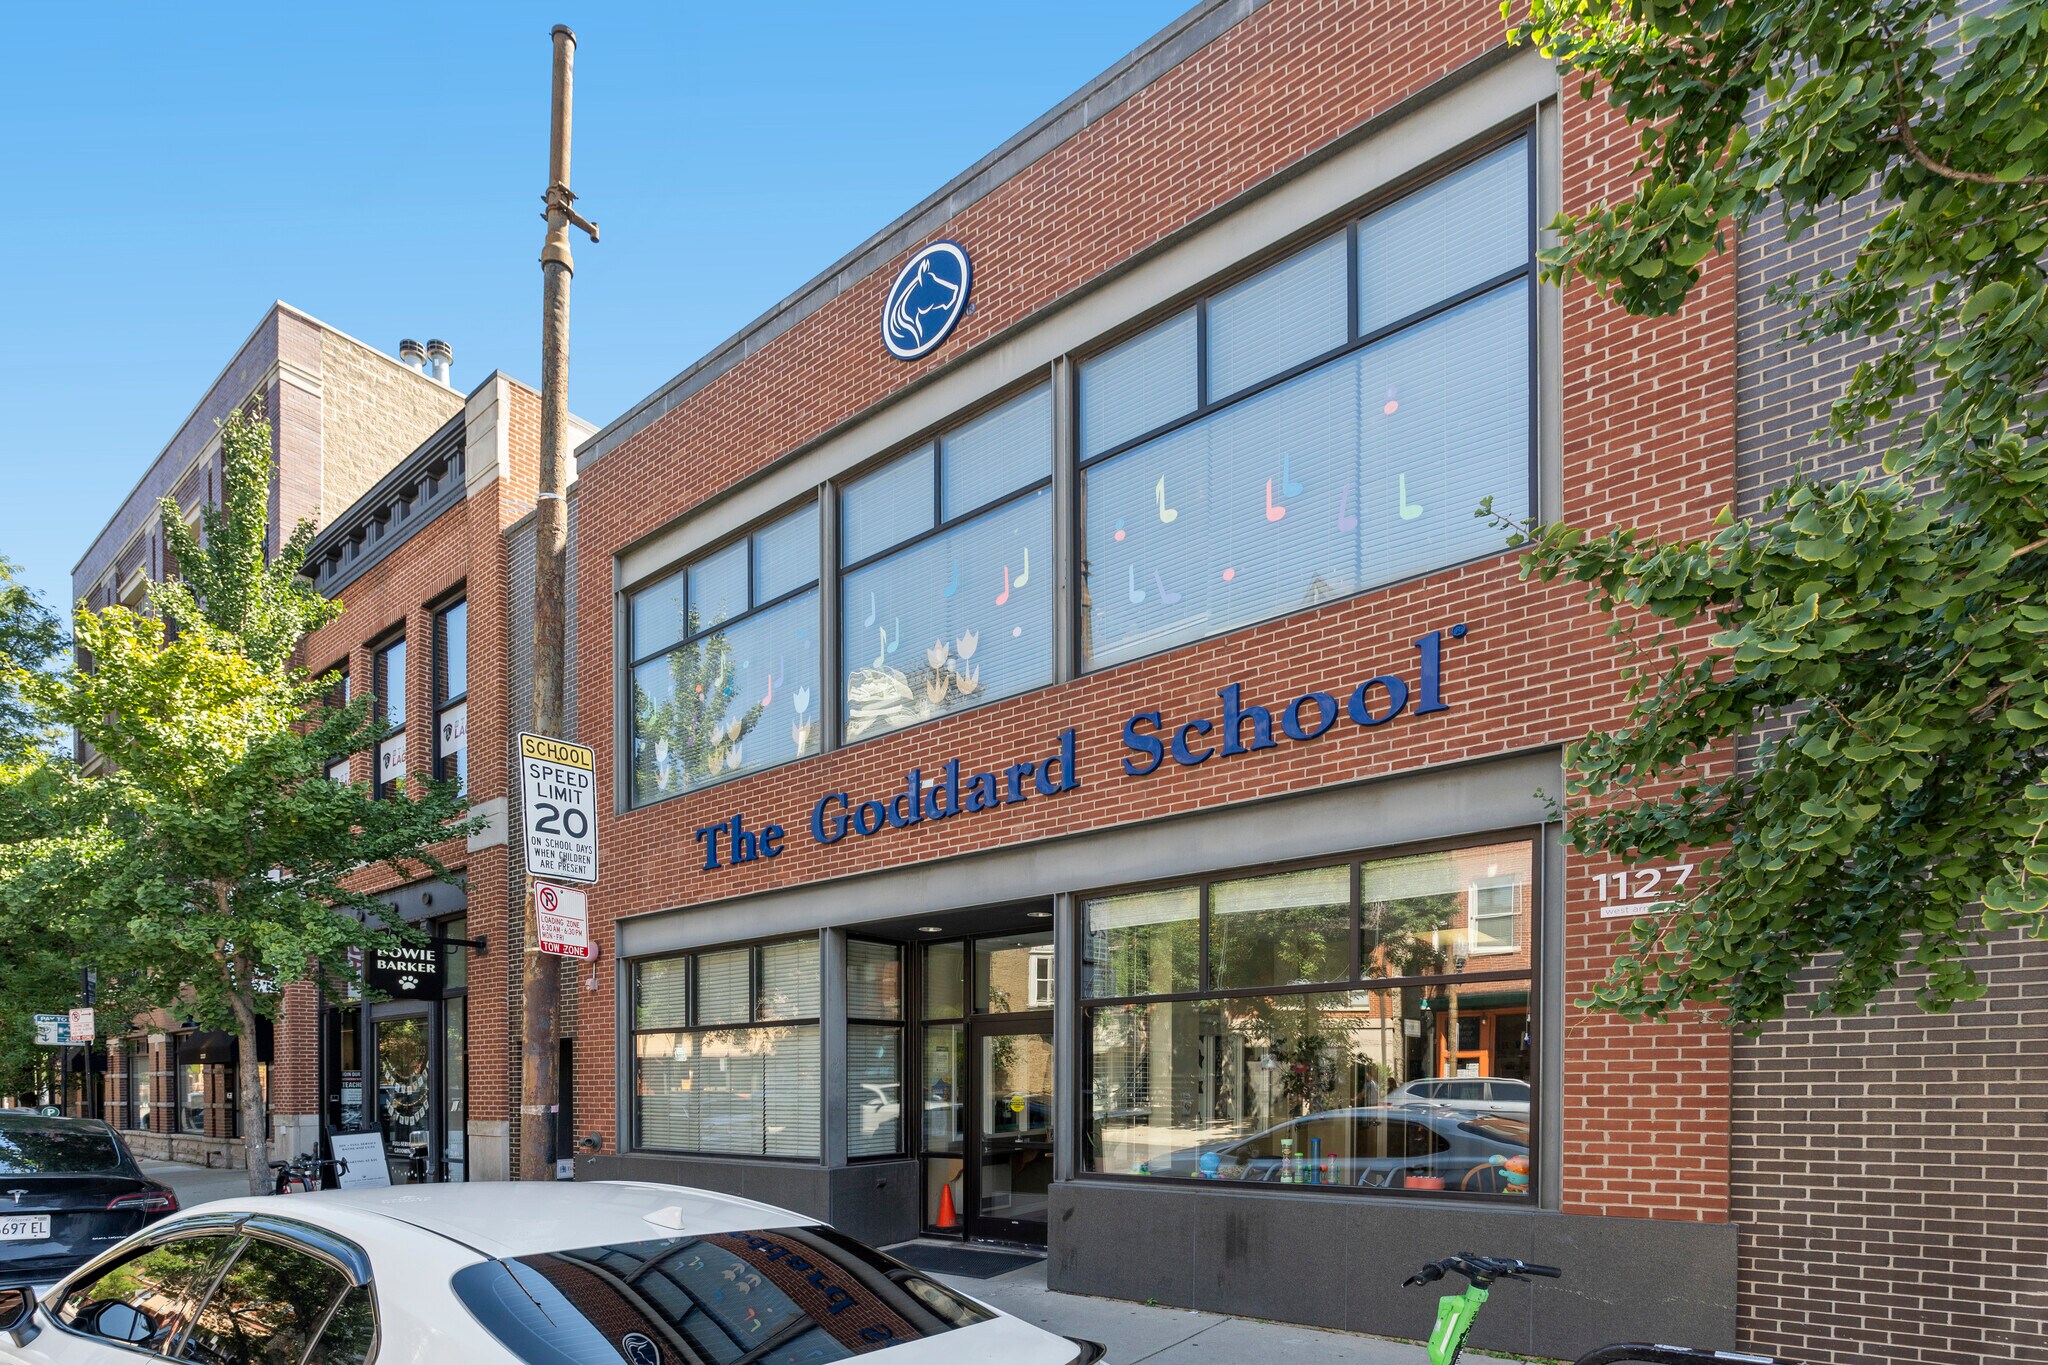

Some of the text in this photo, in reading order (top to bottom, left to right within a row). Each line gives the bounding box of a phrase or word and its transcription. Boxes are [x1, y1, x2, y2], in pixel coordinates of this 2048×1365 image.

[526, 739, 590, 766] SCHOOL
[530, 764, 588, 789] SPEED
[537, 782, 582, 804] LIMIT
[694, 810, 785, 872] The
[810, 728, 1081, 845] Goddard
[534, 803, 588, 839] 20
[531, 836, 593, 855] ON SCHOOL DAYS
[534, 848, 591, 865] WHEN CHILDREN
[540, 859, 554, 870] ARE
[558, 862, 587, 875] PRESENT
[1592, 864, 1693, 902] 1127
[1605, 907, 1629, 915] west
[541, 914, 580, 929] LOADING ZONE
[543, 941, 585, 956] TOW ZONE
[377, 960, 436, 973] BARKER
[0, 1222, 47, 1235] 697 EL
